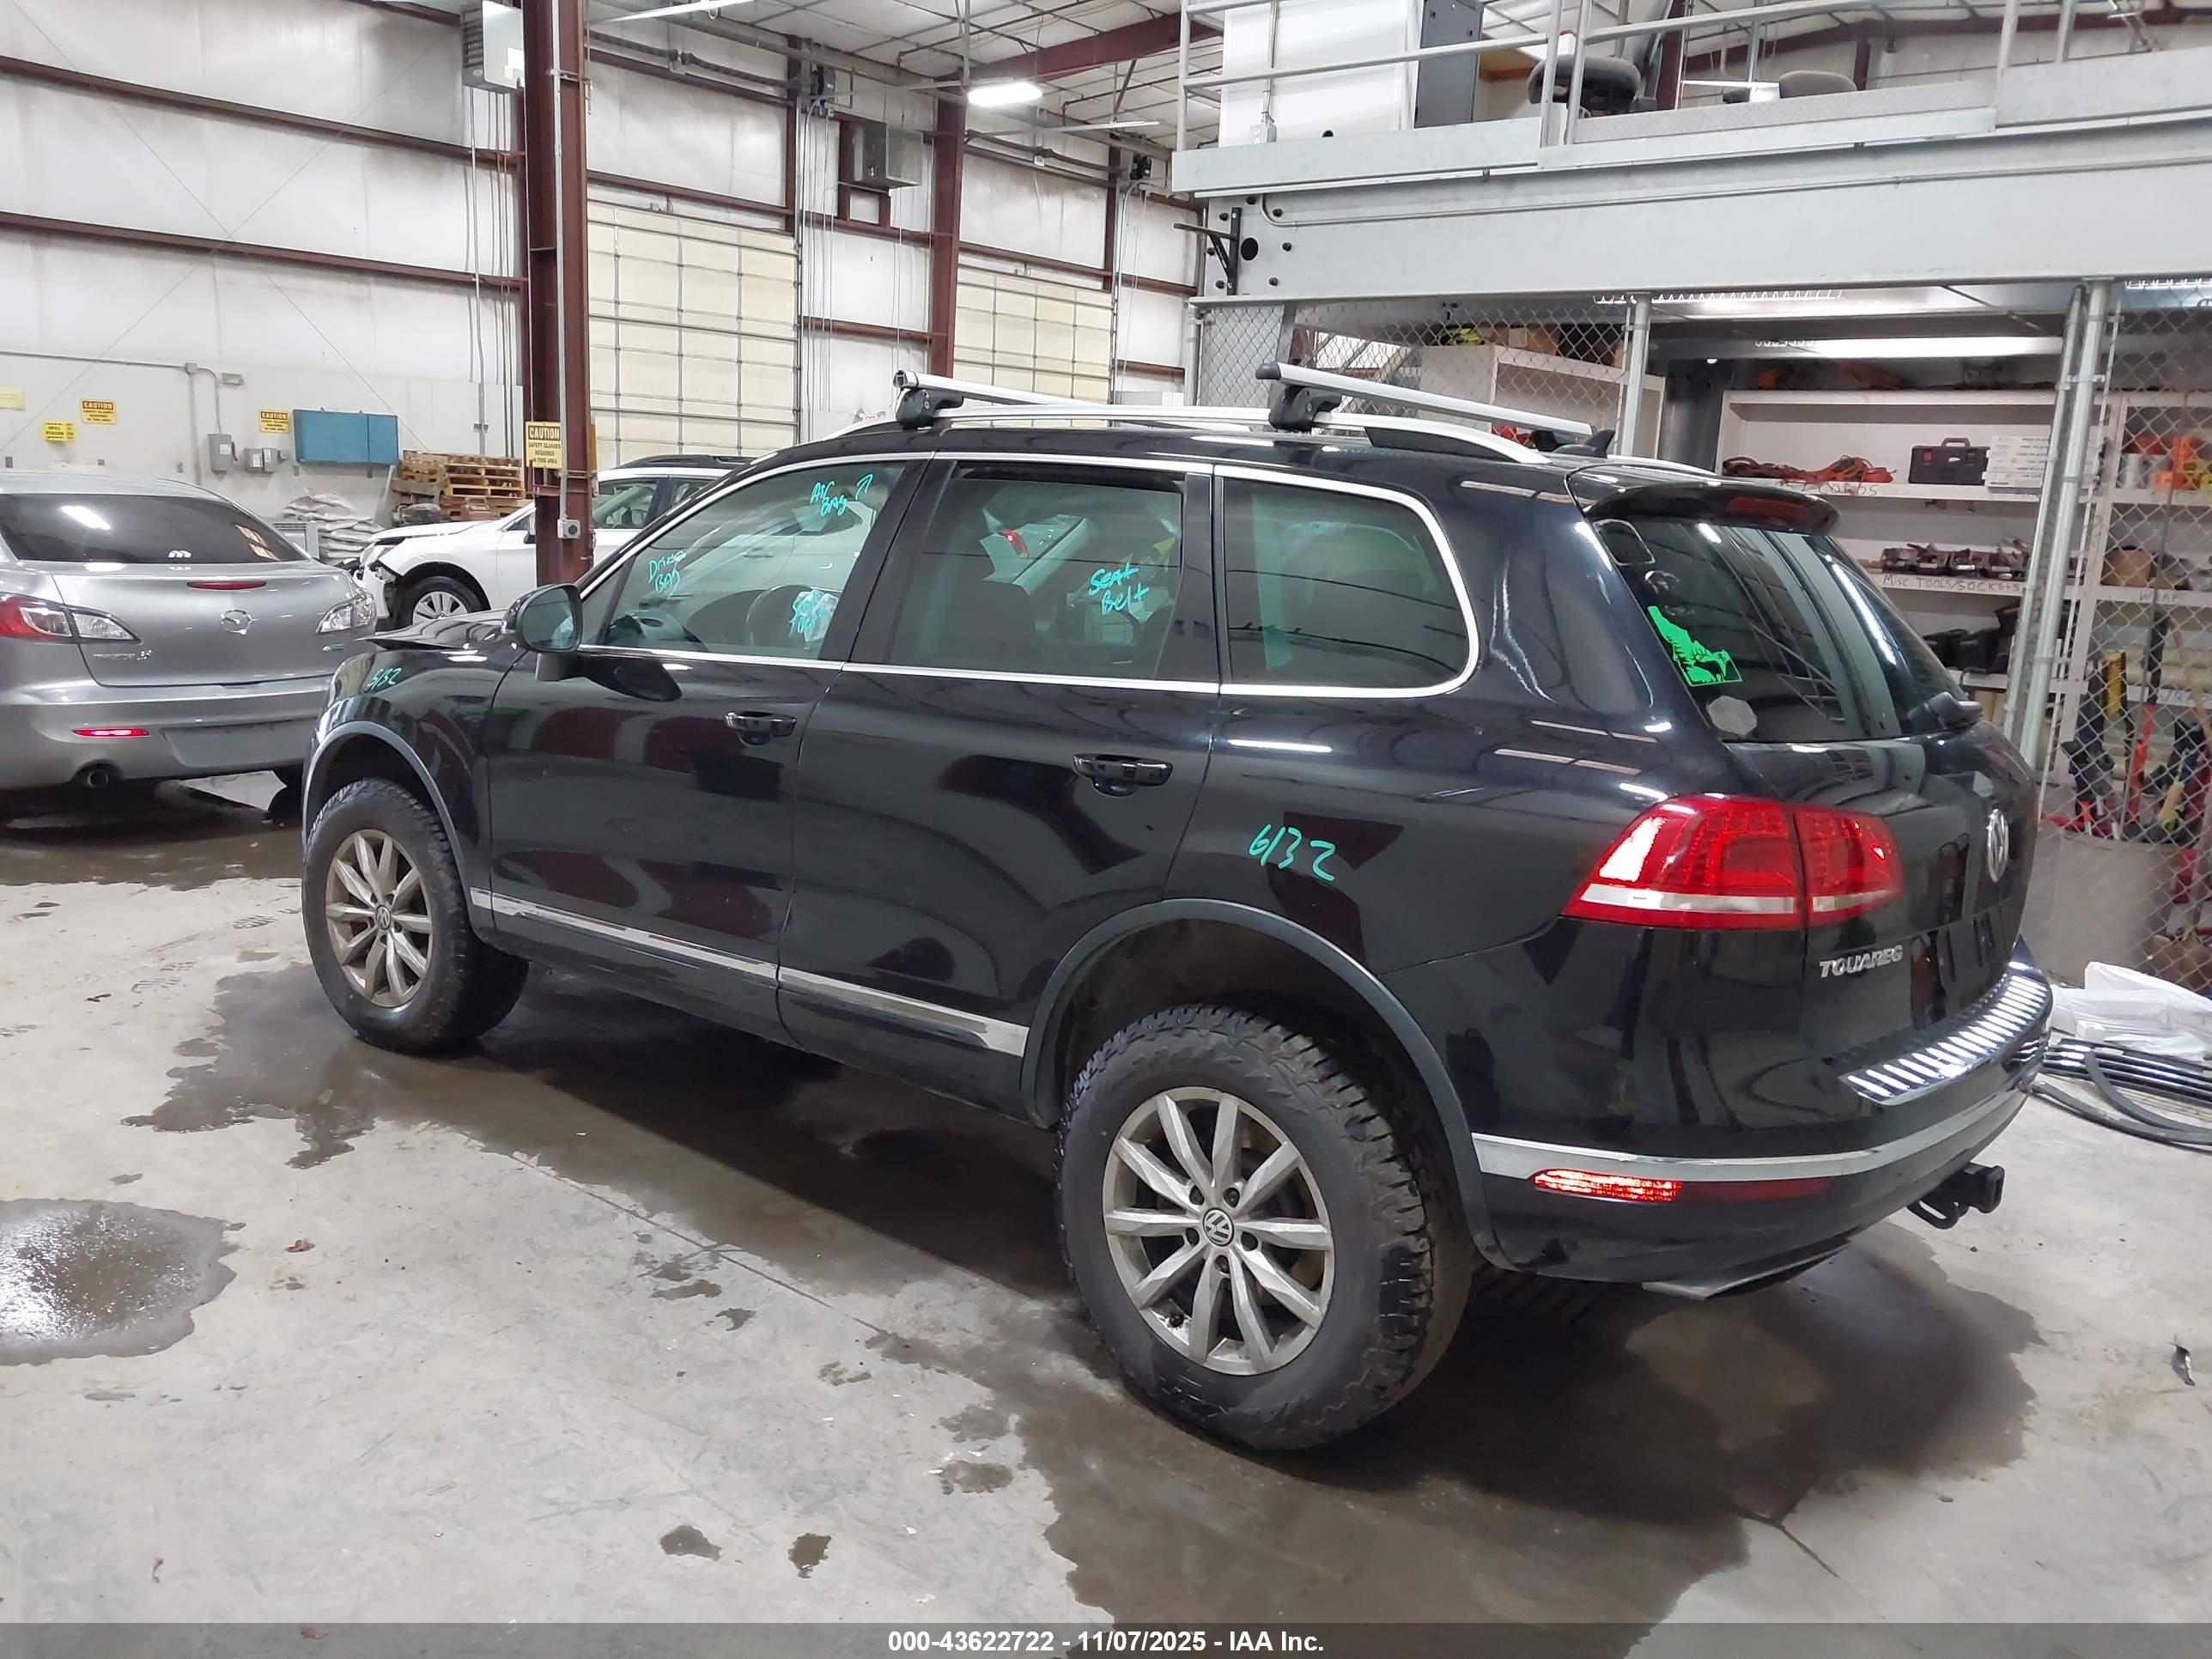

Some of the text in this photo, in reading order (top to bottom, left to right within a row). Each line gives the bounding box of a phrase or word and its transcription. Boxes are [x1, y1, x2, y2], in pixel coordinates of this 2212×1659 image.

[84, 401, 113, 410] CAUTION
[529, 427, 560, 440] CAUTION
[1249, 823, 1335, 881] 6132
[1819, 945, 1903, 978] TOUAREG
